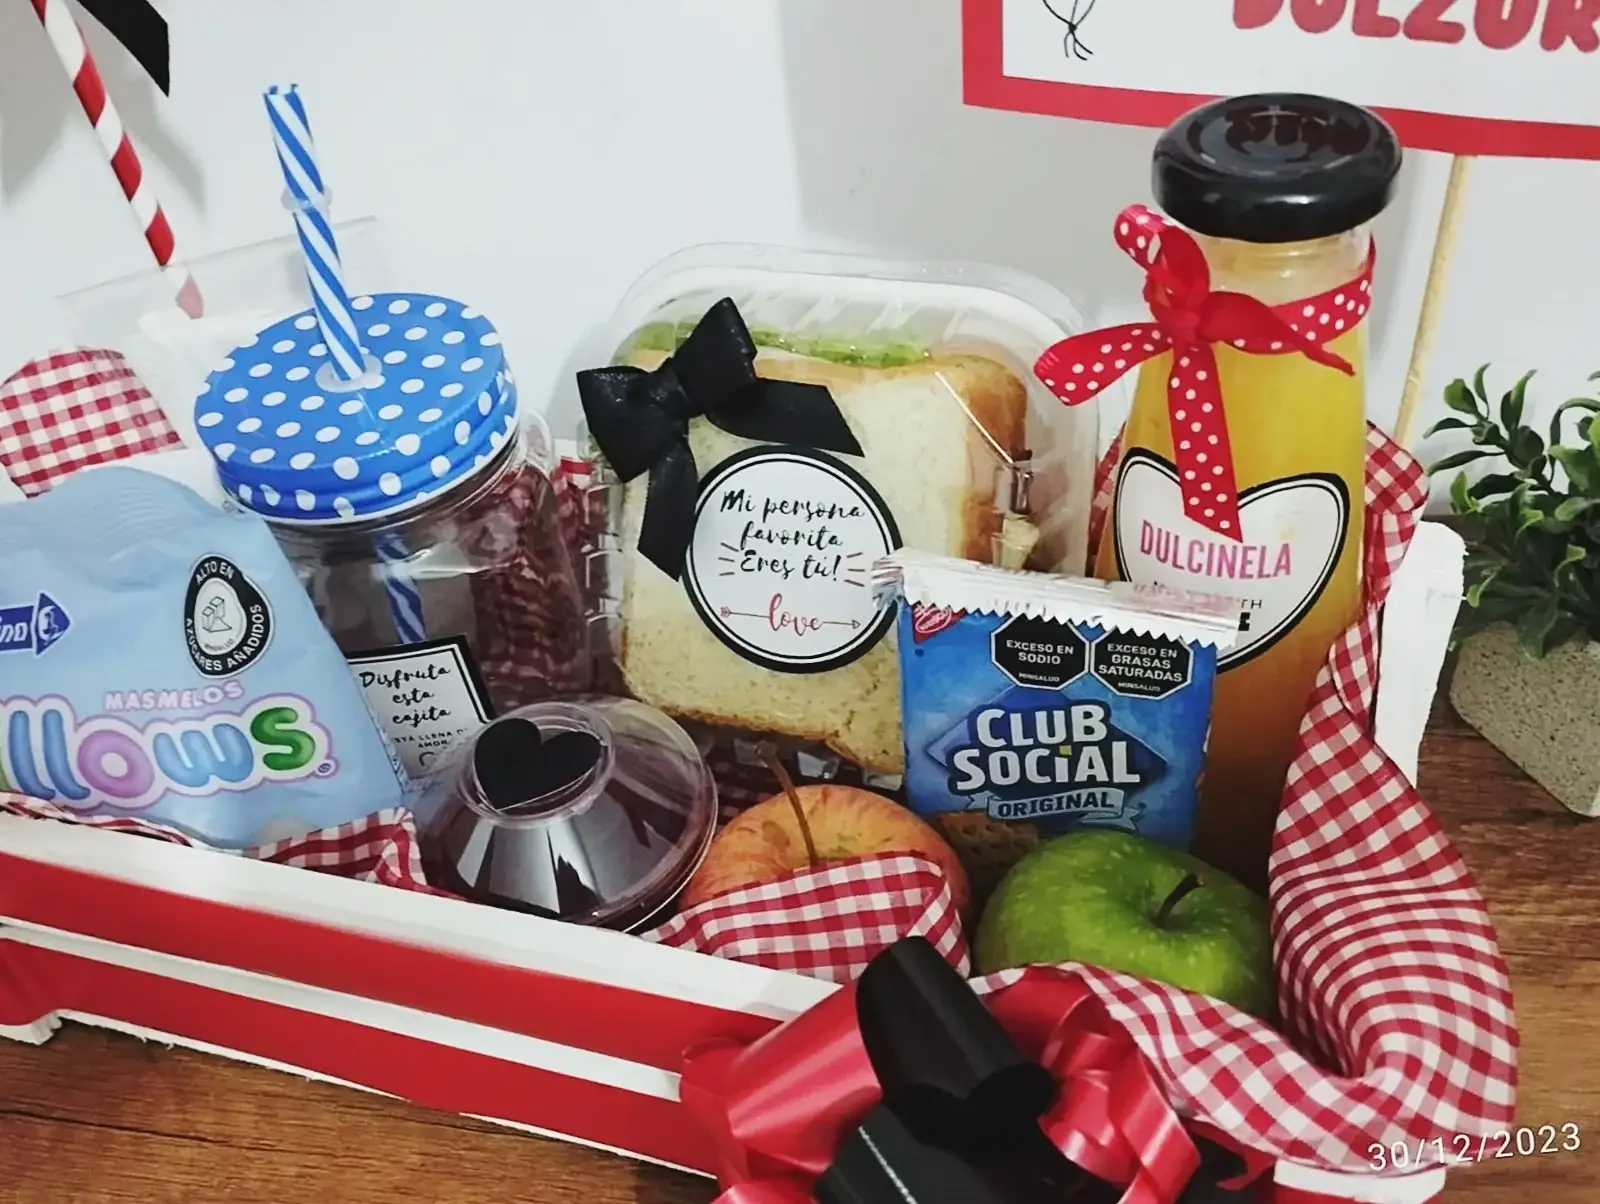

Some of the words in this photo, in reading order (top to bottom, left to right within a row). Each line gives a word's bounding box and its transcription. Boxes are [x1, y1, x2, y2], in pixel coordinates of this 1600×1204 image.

[720, 489, 756, 512] Mi
[762, 497, 865, 523] persona
[740, 520, 843, 551] favorita
[1140, 519, 1292, 579] DULCINELA
[195, 561, 218, 584] ALTO
[220, 562, 235, 580] EN
[740, 549, 795, 580] Eres
[769, 593, 823, 636] love
[225, 604, 265, 668] AÑADIDOS
[1006, 639, 1054, 653] EXCESO
[1057, 644, 1074, 655] EN
[1018, 652, 1061, 665] SODIO
[1107, 643, 1157, 656] EXCESO
[1160, 648, 1178, 659] EN
[1111, 654, 1171, 670] GRASAS
[359, 664, 451, 689] Disfruta
[1098, 664, 1183, 682] SATURADAS
[104, 680, 244, 713] MASMELOS
[392, 688, 434, 706] esta
[392, 706, 451, 728] cajita
[976, 704, 1108, 749] CLUB
[0, 706, 317, 801] llows
[998, 790, 1114, 818] ORIGINAL
